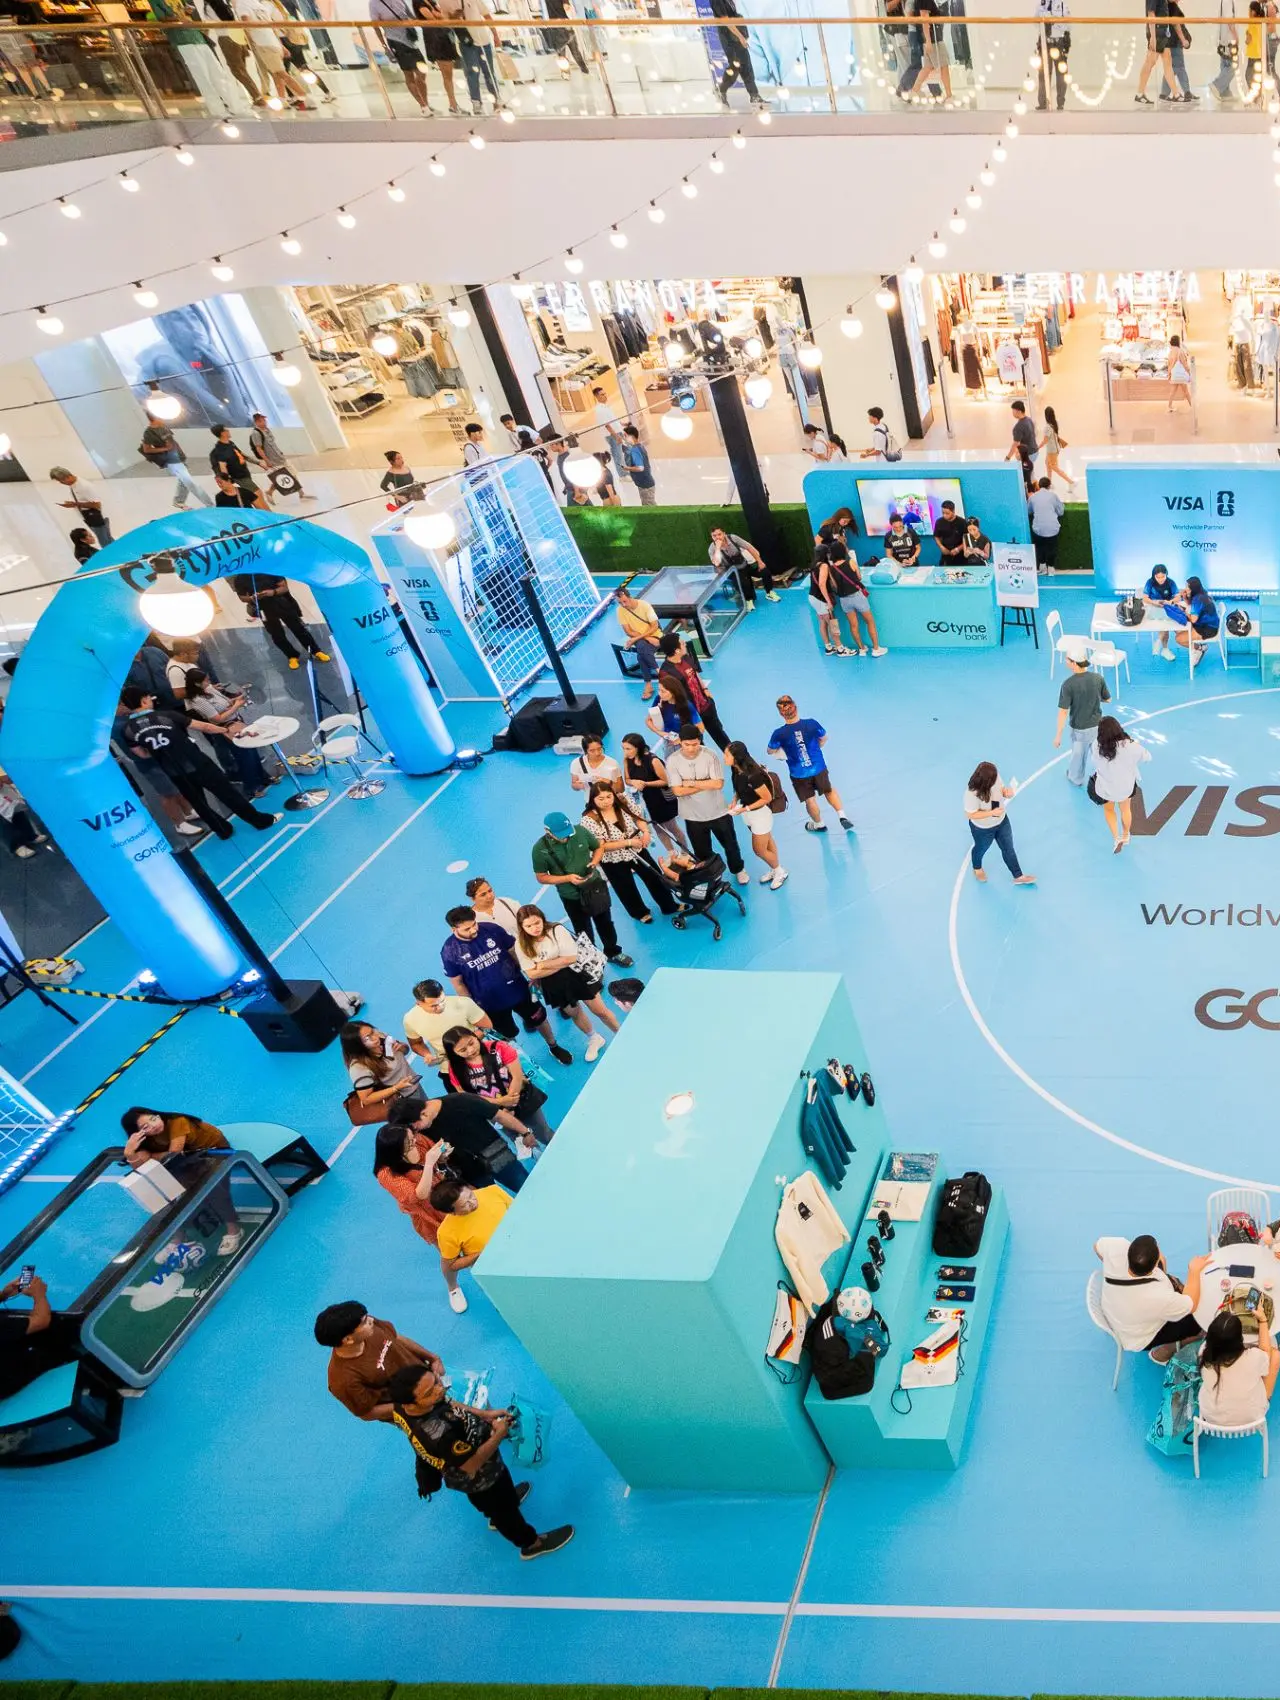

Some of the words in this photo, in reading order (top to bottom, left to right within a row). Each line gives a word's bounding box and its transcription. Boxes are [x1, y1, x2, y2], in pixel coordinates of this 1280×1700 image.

[1162, 496, 1204, 511] VISA
[1181, 540, 1217, 549] GOtyme
[401, 579, 431, 588] VISA
[352, 606, 391, 629] VISA
[927, 621, 986, 635] GOtyme
[145, 733, 170, 750] 26
[80, 800, 136, 831] VISA
[467, 947, 501, 969] Emirates
